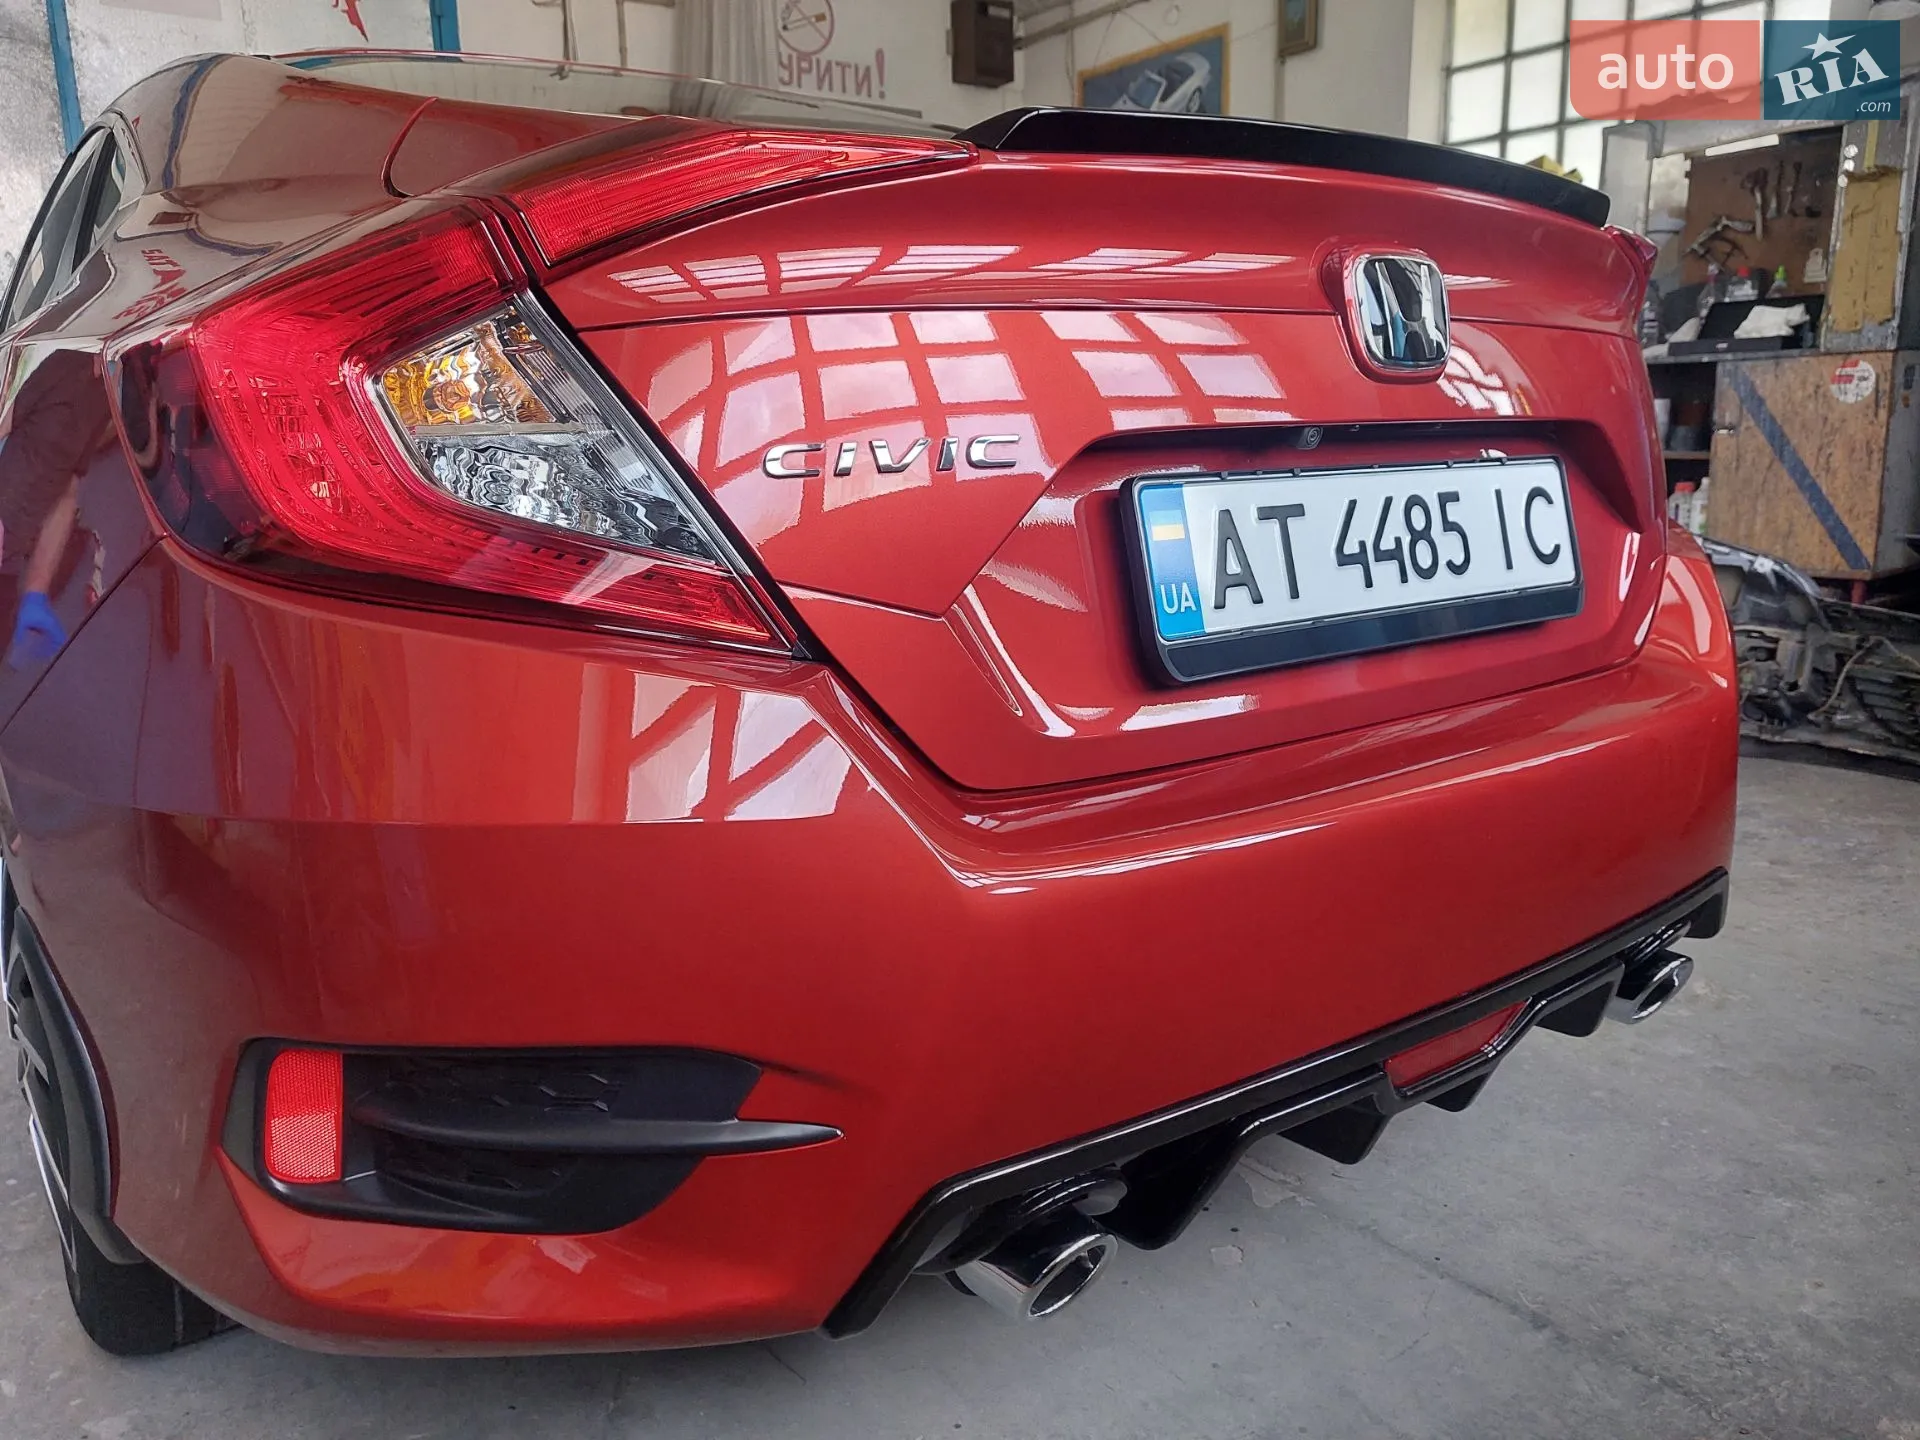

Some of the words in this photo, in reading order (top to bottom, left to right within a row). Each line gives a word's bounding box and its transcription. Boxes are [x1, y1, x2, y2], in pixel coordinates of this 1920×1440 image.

[763, 433, 1021, 479] CIVIC
[1213, 503, 1305, 609] AT
[1337, 490, 1471, 588] 4485
[1495, 486, 1561, 570] IC
[1160, 582, 1197, 614] UA
